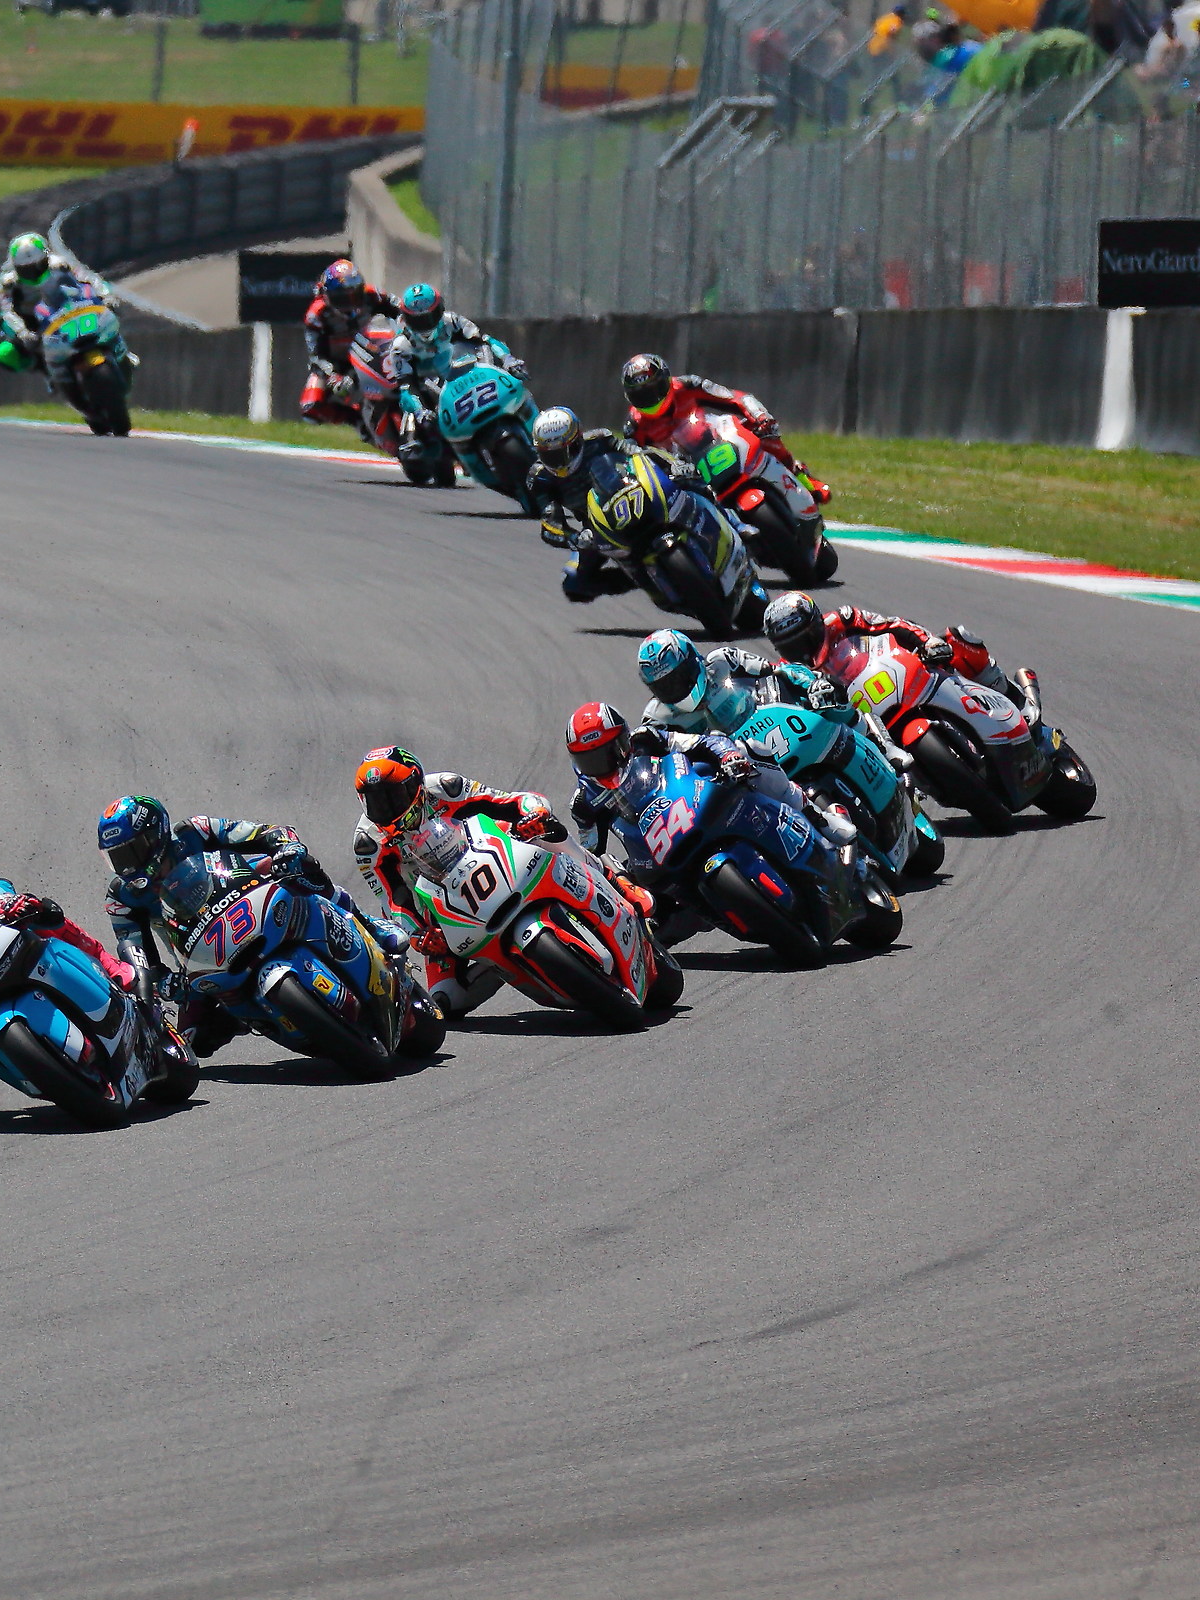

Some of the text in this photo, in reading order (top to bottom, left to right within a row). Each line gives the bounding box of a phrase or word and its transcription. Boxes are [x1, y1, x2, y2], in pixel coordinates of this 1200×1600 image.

[454, 380, 499, 425] 52
[697, 442, 738, 485] 19
[612, 486, 645, 531] 97
[645, 796, 696, 865] 54
[460, 863, 498, 916] 10
[184, 913, 213, 953] DRIBBLE
[203, 897, 257, 967] 73
